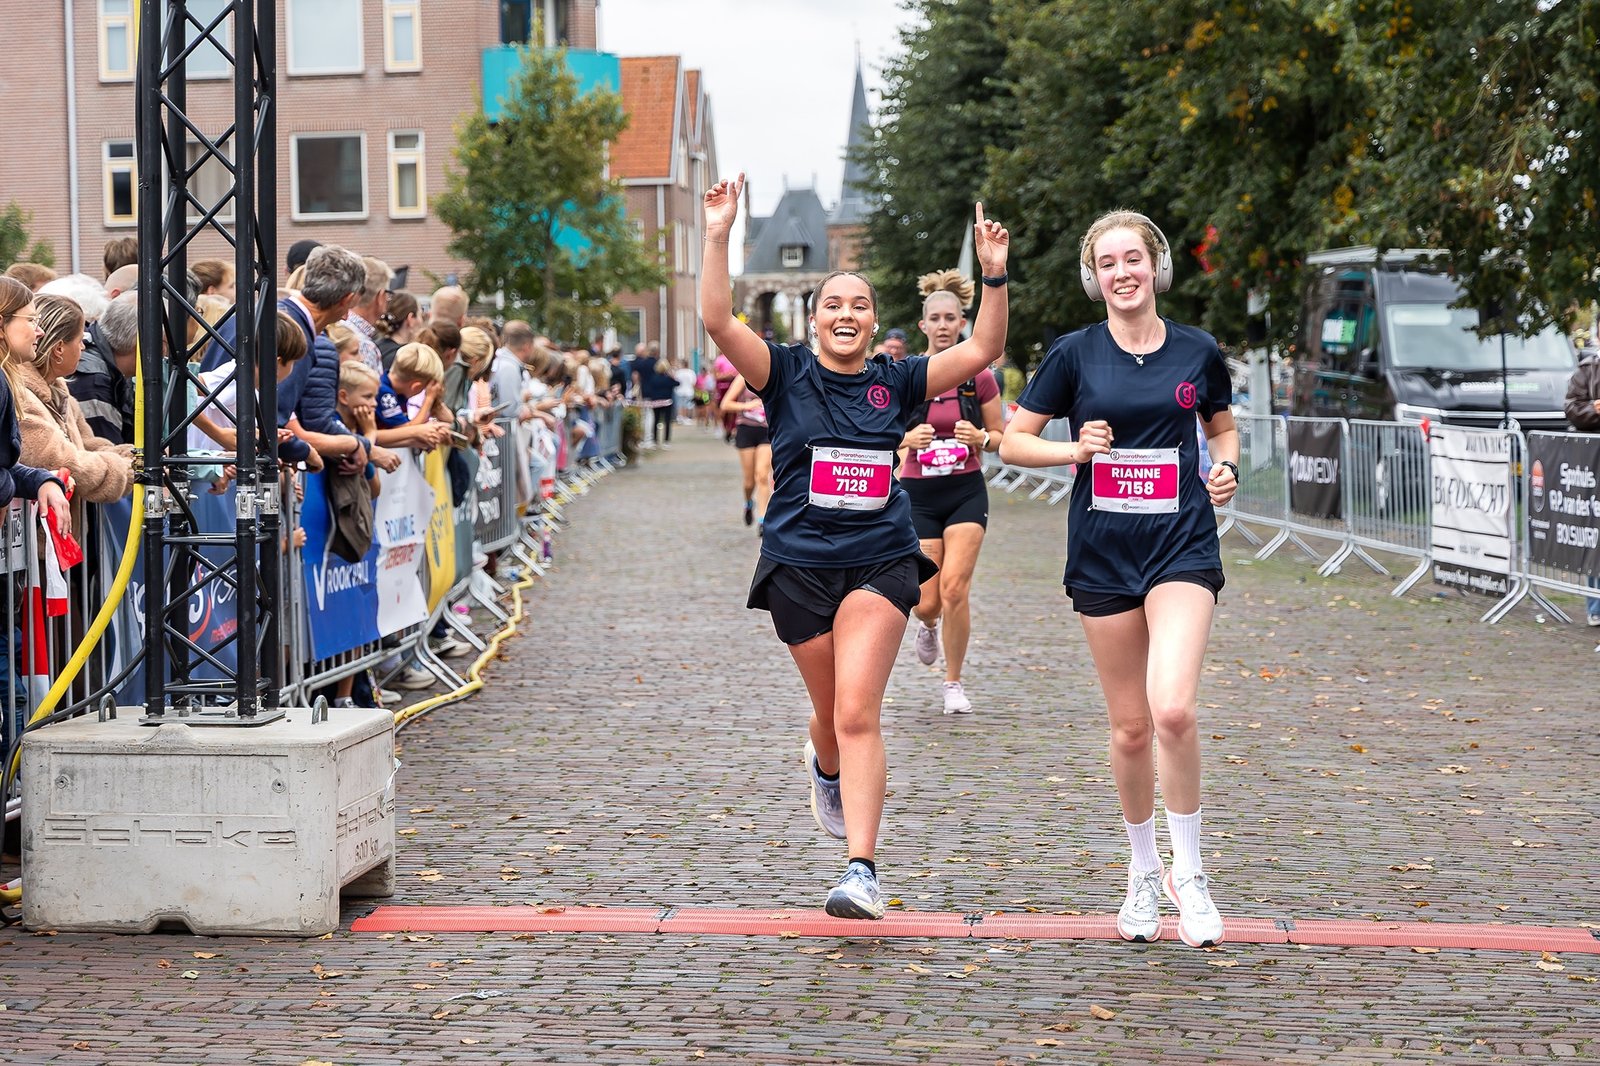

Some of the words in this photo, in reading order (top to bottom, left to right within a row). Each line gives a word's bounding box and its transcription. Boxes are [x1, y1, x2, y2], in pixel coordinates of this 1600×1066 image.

[832, 465, 875, 478] NAOMI
[1111, 467, 1161, 479] RIANNE
[836, 478, 868, 493] 7128
[1117, 480, 1154, 496] 7158
